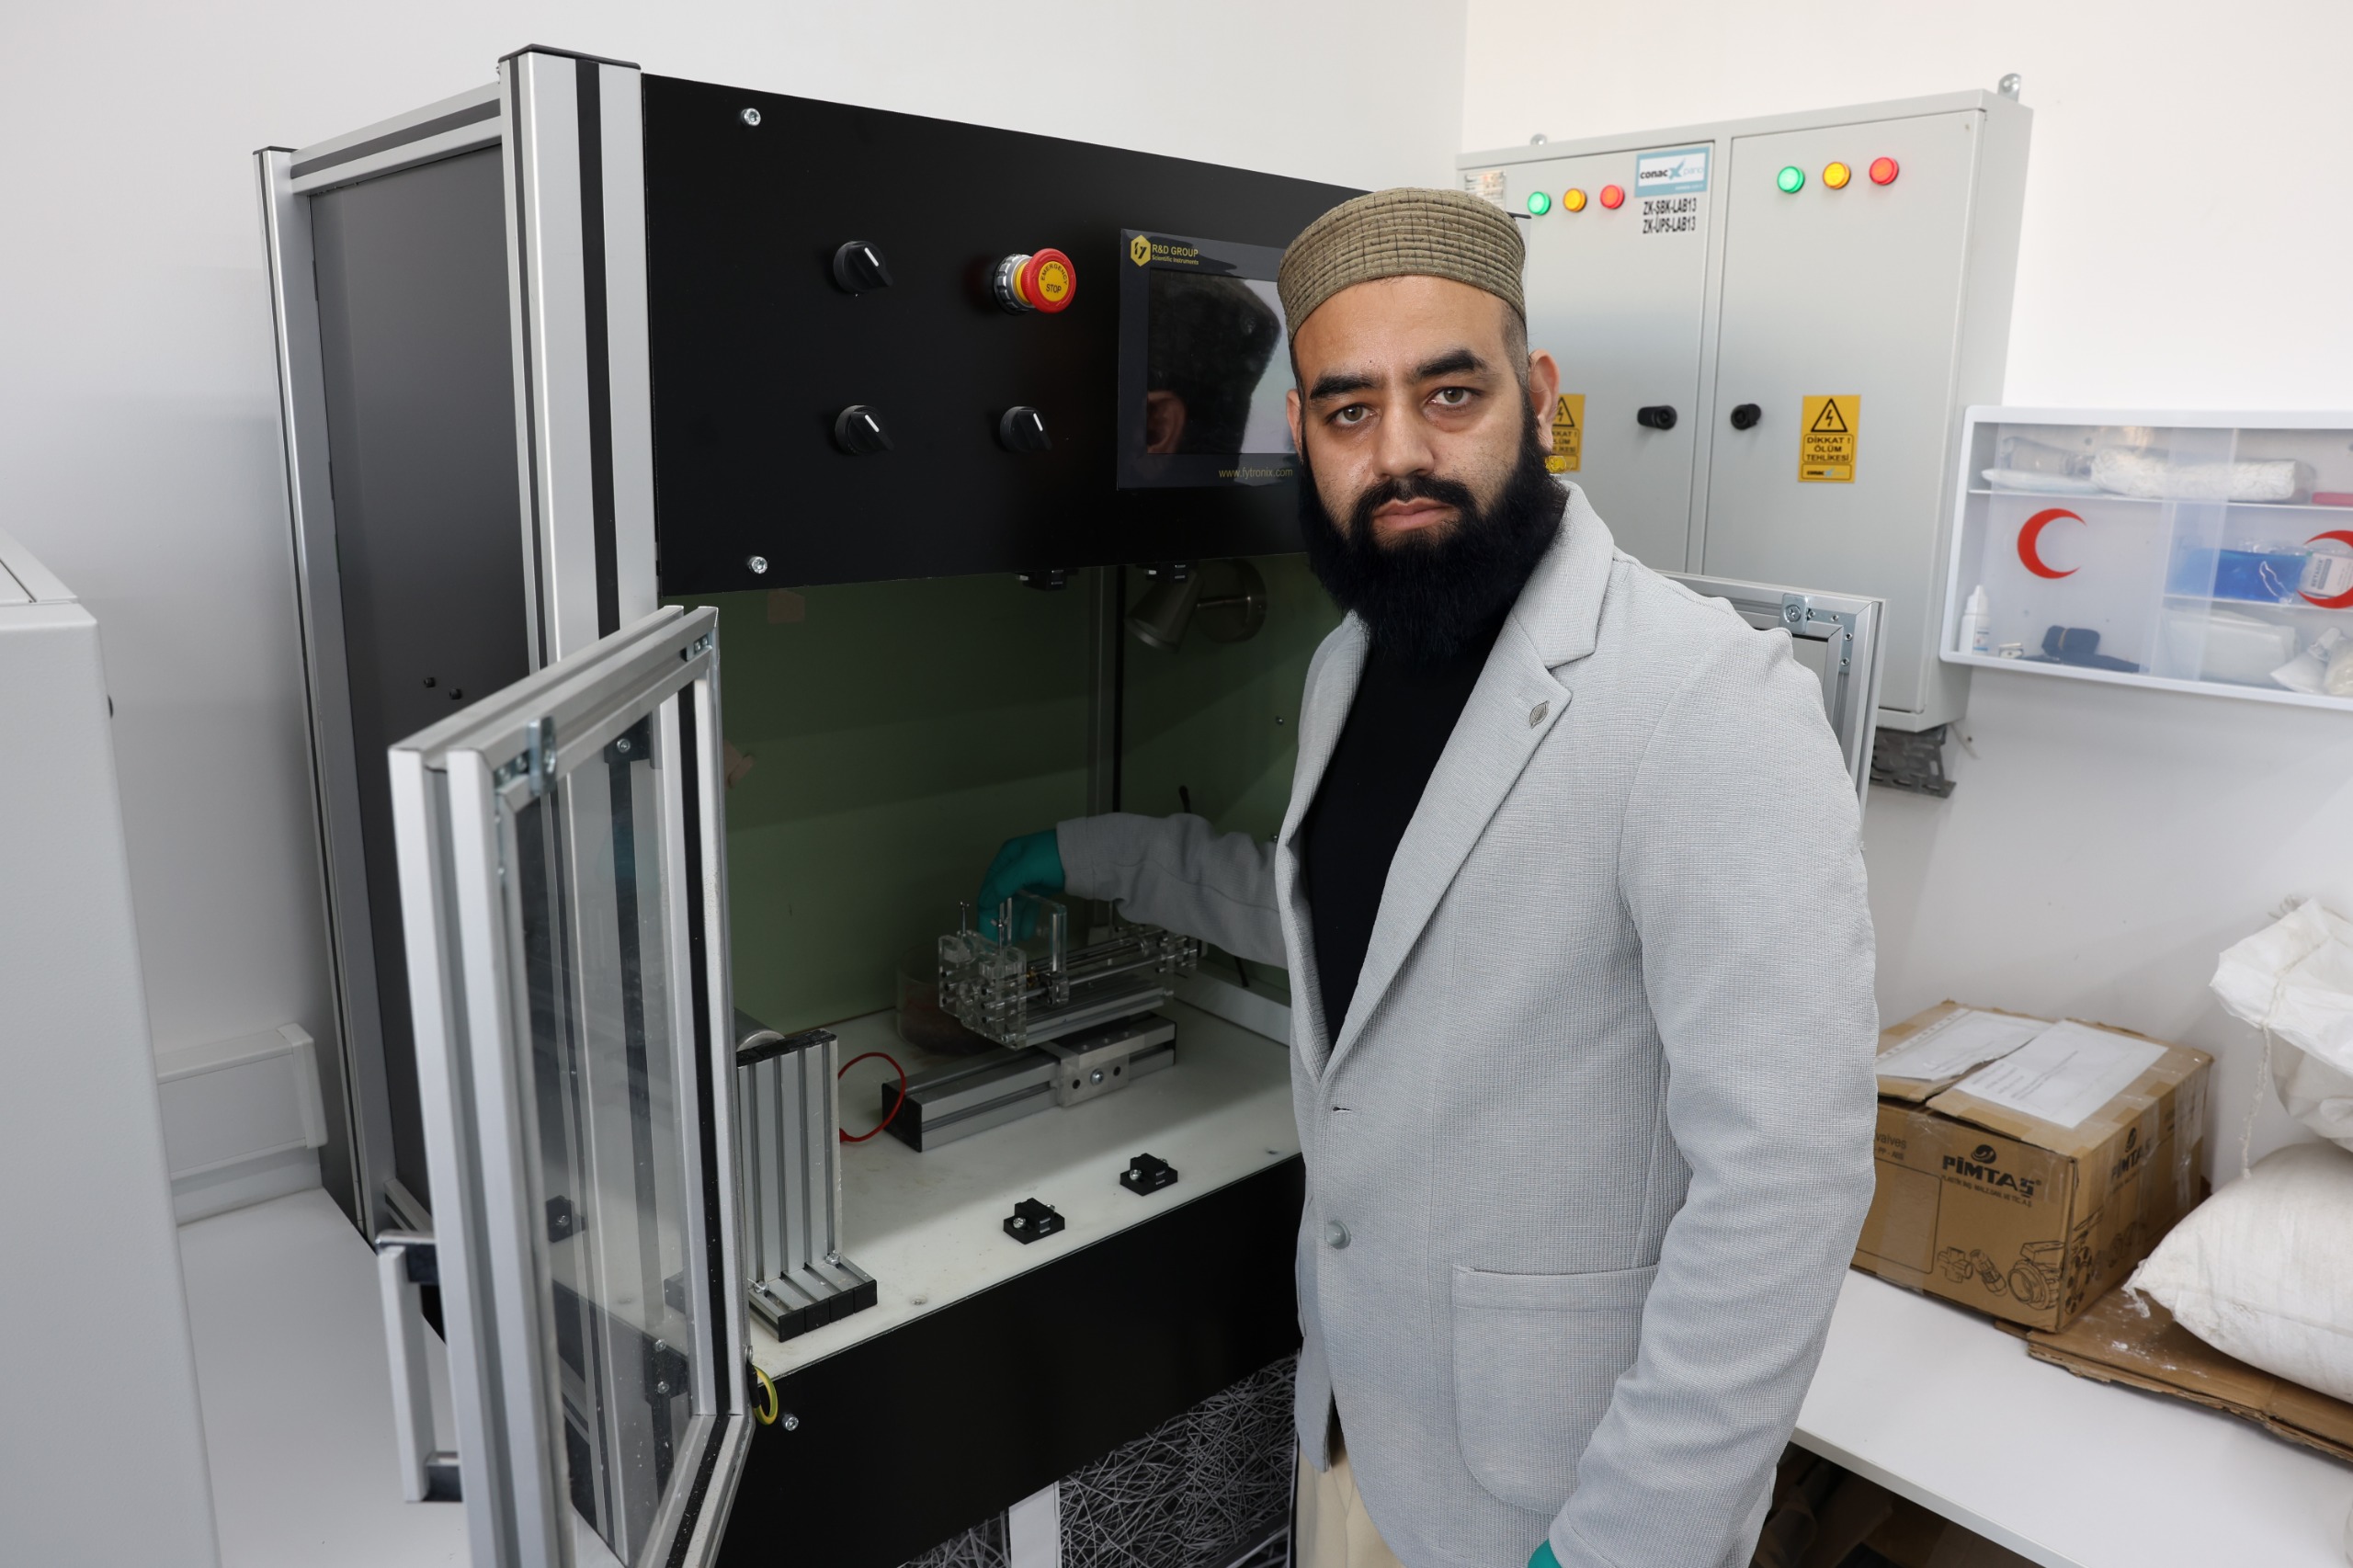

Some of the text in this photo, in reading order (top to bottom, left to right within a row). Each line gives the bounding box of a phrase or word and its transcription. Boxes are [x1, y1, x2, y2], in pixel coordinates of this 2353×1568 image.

[1643, 197, 1697, 216] ZK-SBK-LAB13
[1643, 215, 1696, 234] ZK-UPS-LAB13
[1152, 244, 1199, 257] R&D GROUP
[1152, 254, 1199, 266] Scientific Instruments
[1040, 263, 1068, 285] EMERGENCY
[1046, 283, 1062, 293] STOP
[1807, 436, 1844, 444] DİKKAT
[1806, 453, 1849, 461] TEHLİKESİ
[1218, 467, 1293, 480] www.fytronix.com
